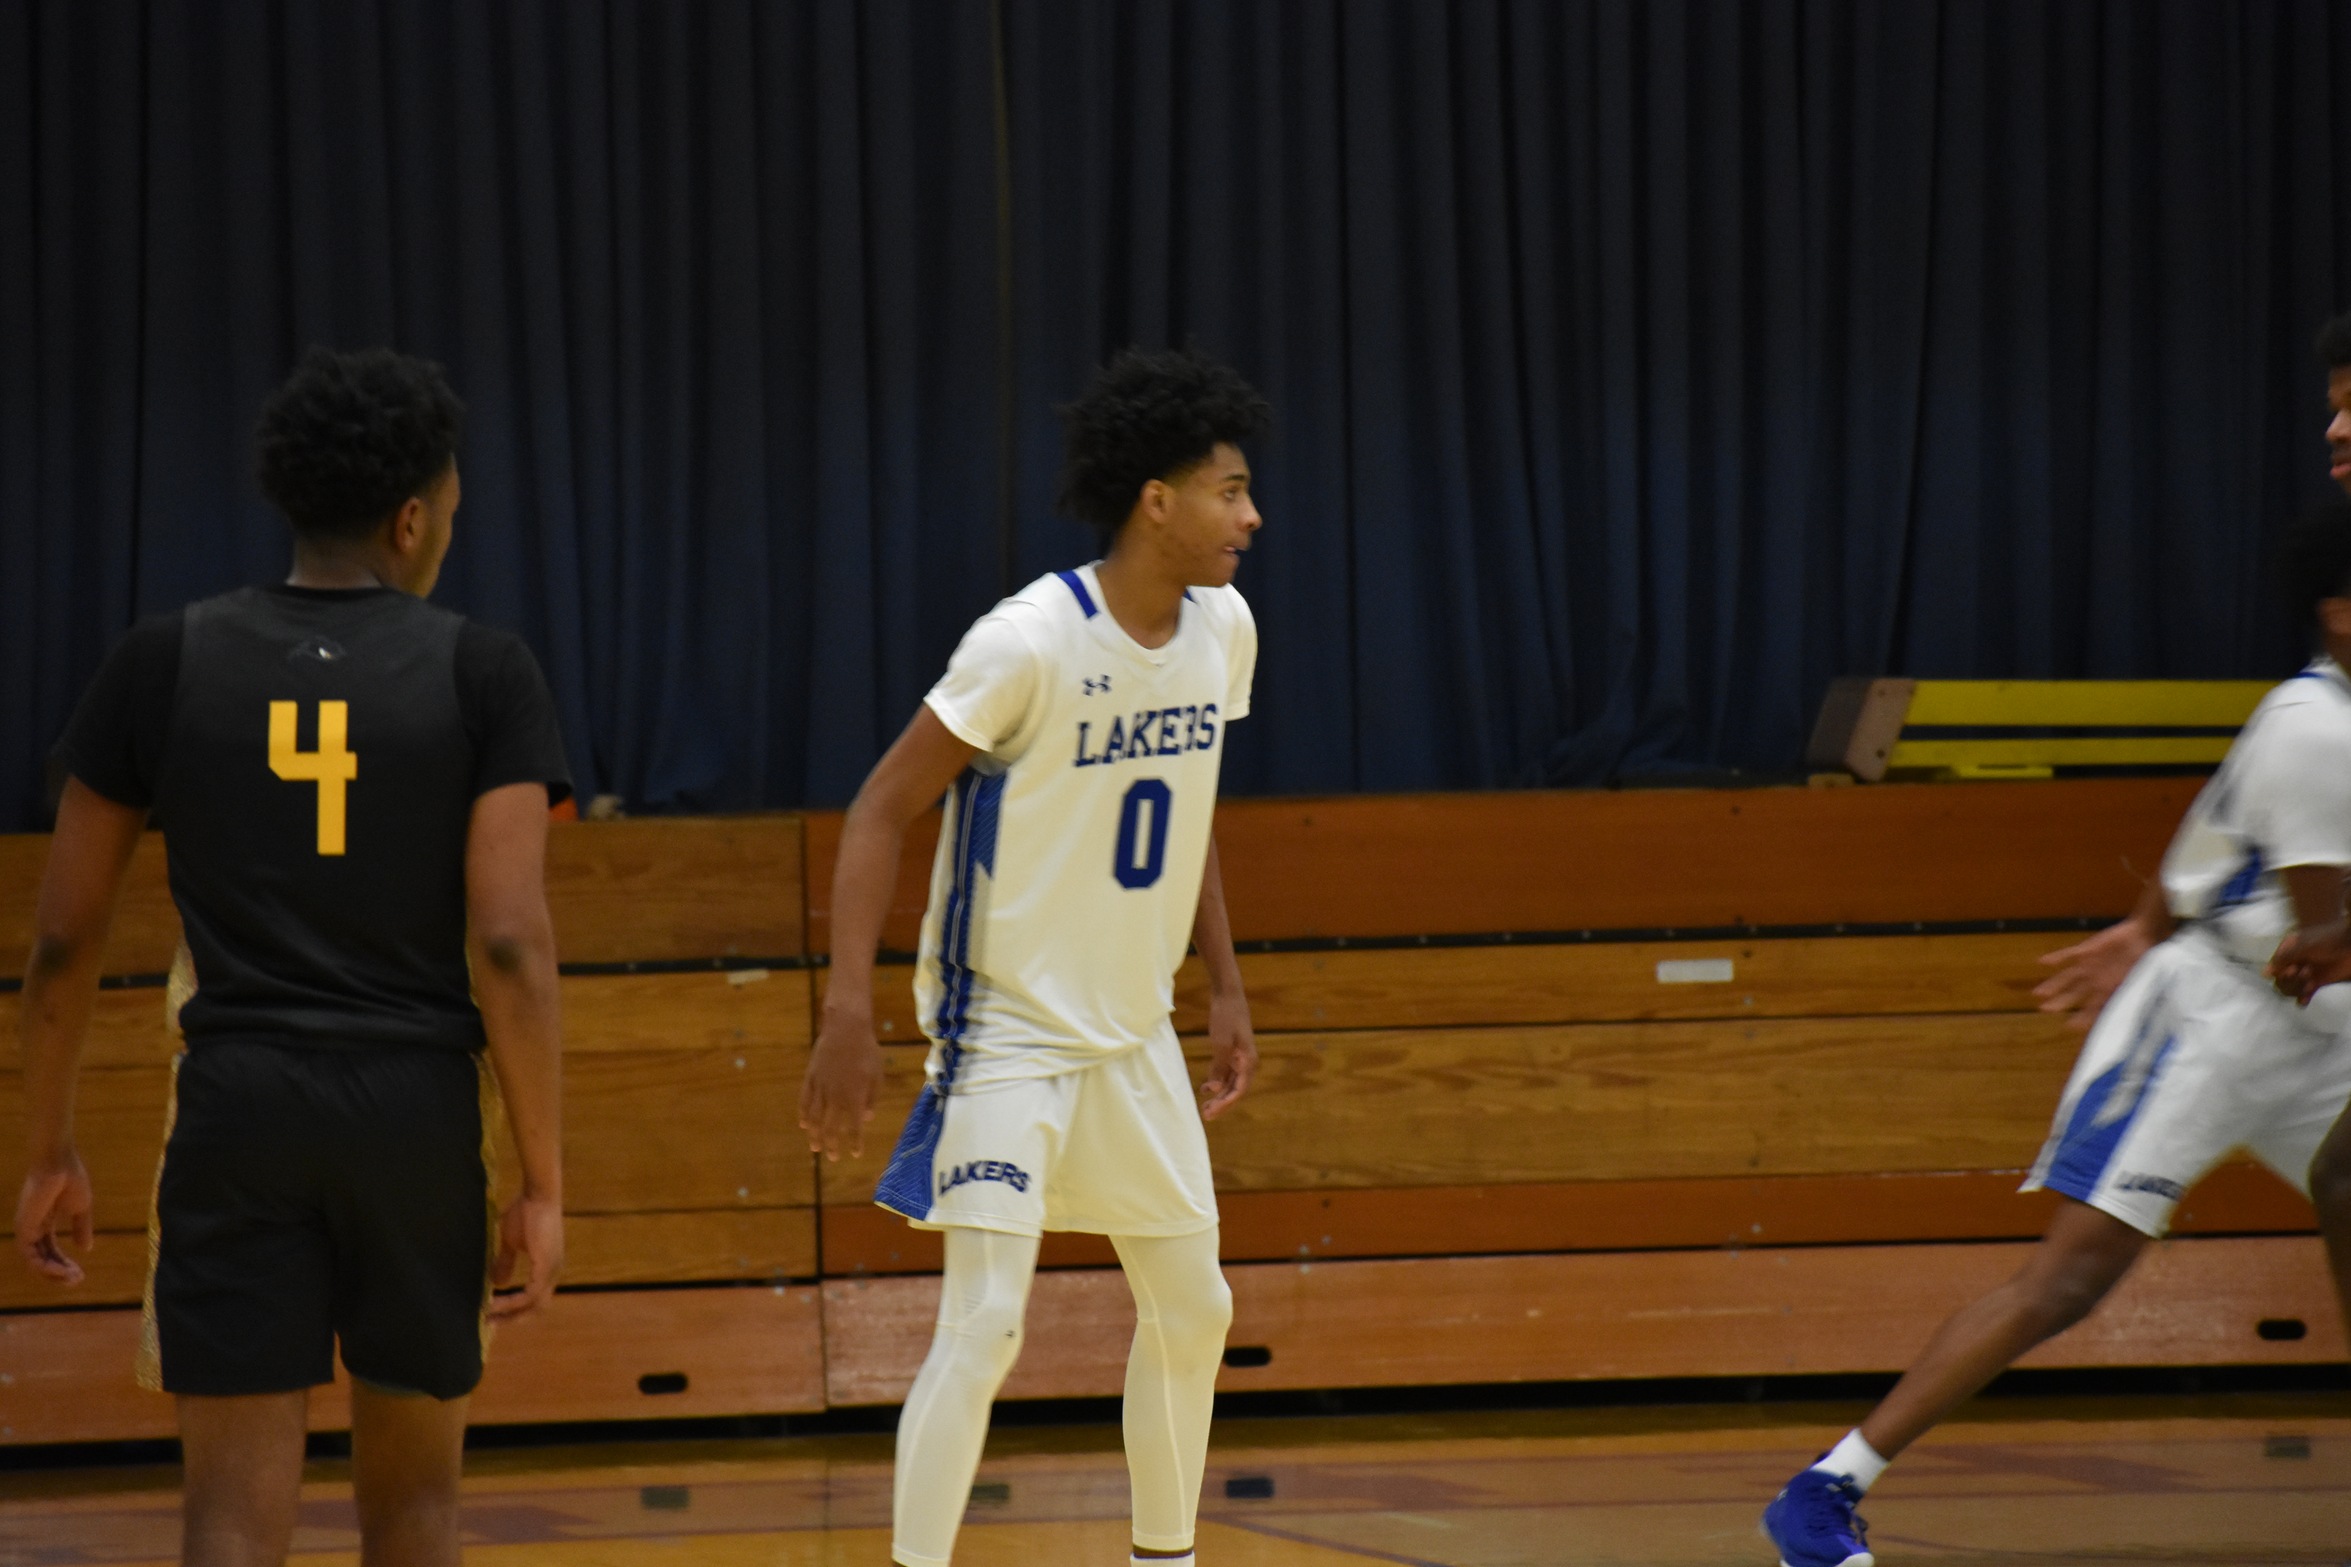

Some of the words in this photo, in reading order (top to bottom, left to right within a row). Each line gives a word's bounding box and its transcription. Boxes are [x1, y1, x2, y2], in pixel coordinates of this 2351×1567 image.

[267, 700, 357, 856] 4
[1074, 702, 1218, 768] LAKERS
[1113, 778, 1172, 888] 0
[939, 1160, 1030, 1197] LAKERS
